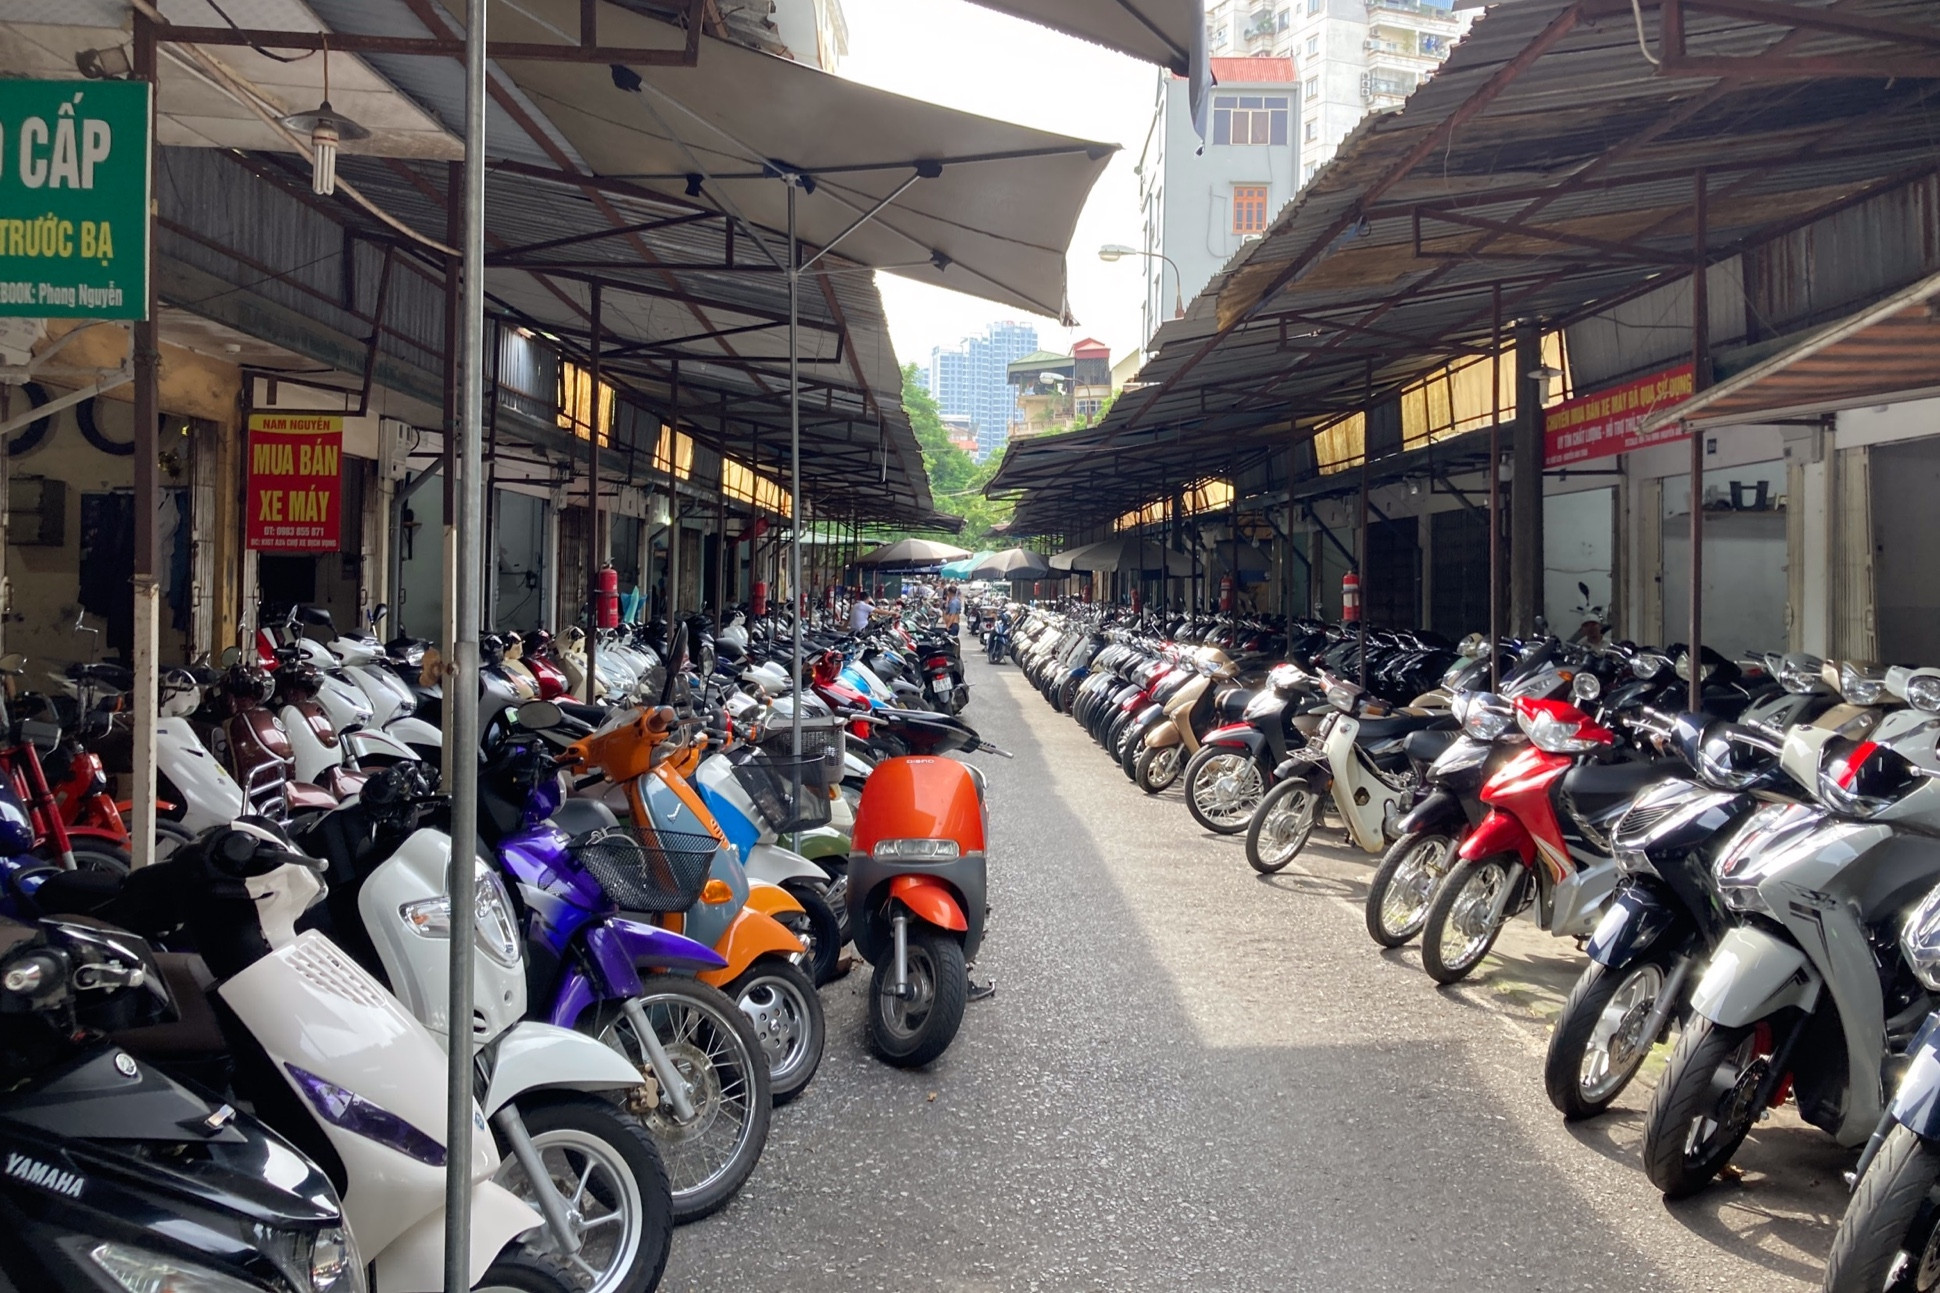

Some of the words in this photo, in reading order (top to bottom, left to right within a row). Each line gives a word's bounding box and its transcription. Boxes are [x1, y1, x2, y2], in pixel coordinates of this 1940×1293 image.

[20, 92, 112, 189] CẤP
[0, 212, 73, 257] TRƯỚC
[81, 221, 114, 266] BẠ
[0, 282, 36, 304] BOOK:
[39, 284, 76, 308] Phong
[263, 418, 287, 430] NAM
[253, 444, 294, 475] MUA
[299, 438, 338, 476] BÁN
[259, 490, 283, 521] XE
[288, 484, 330, 522] MÁY
[4, 1152, 86, 1198] YAMAHA
